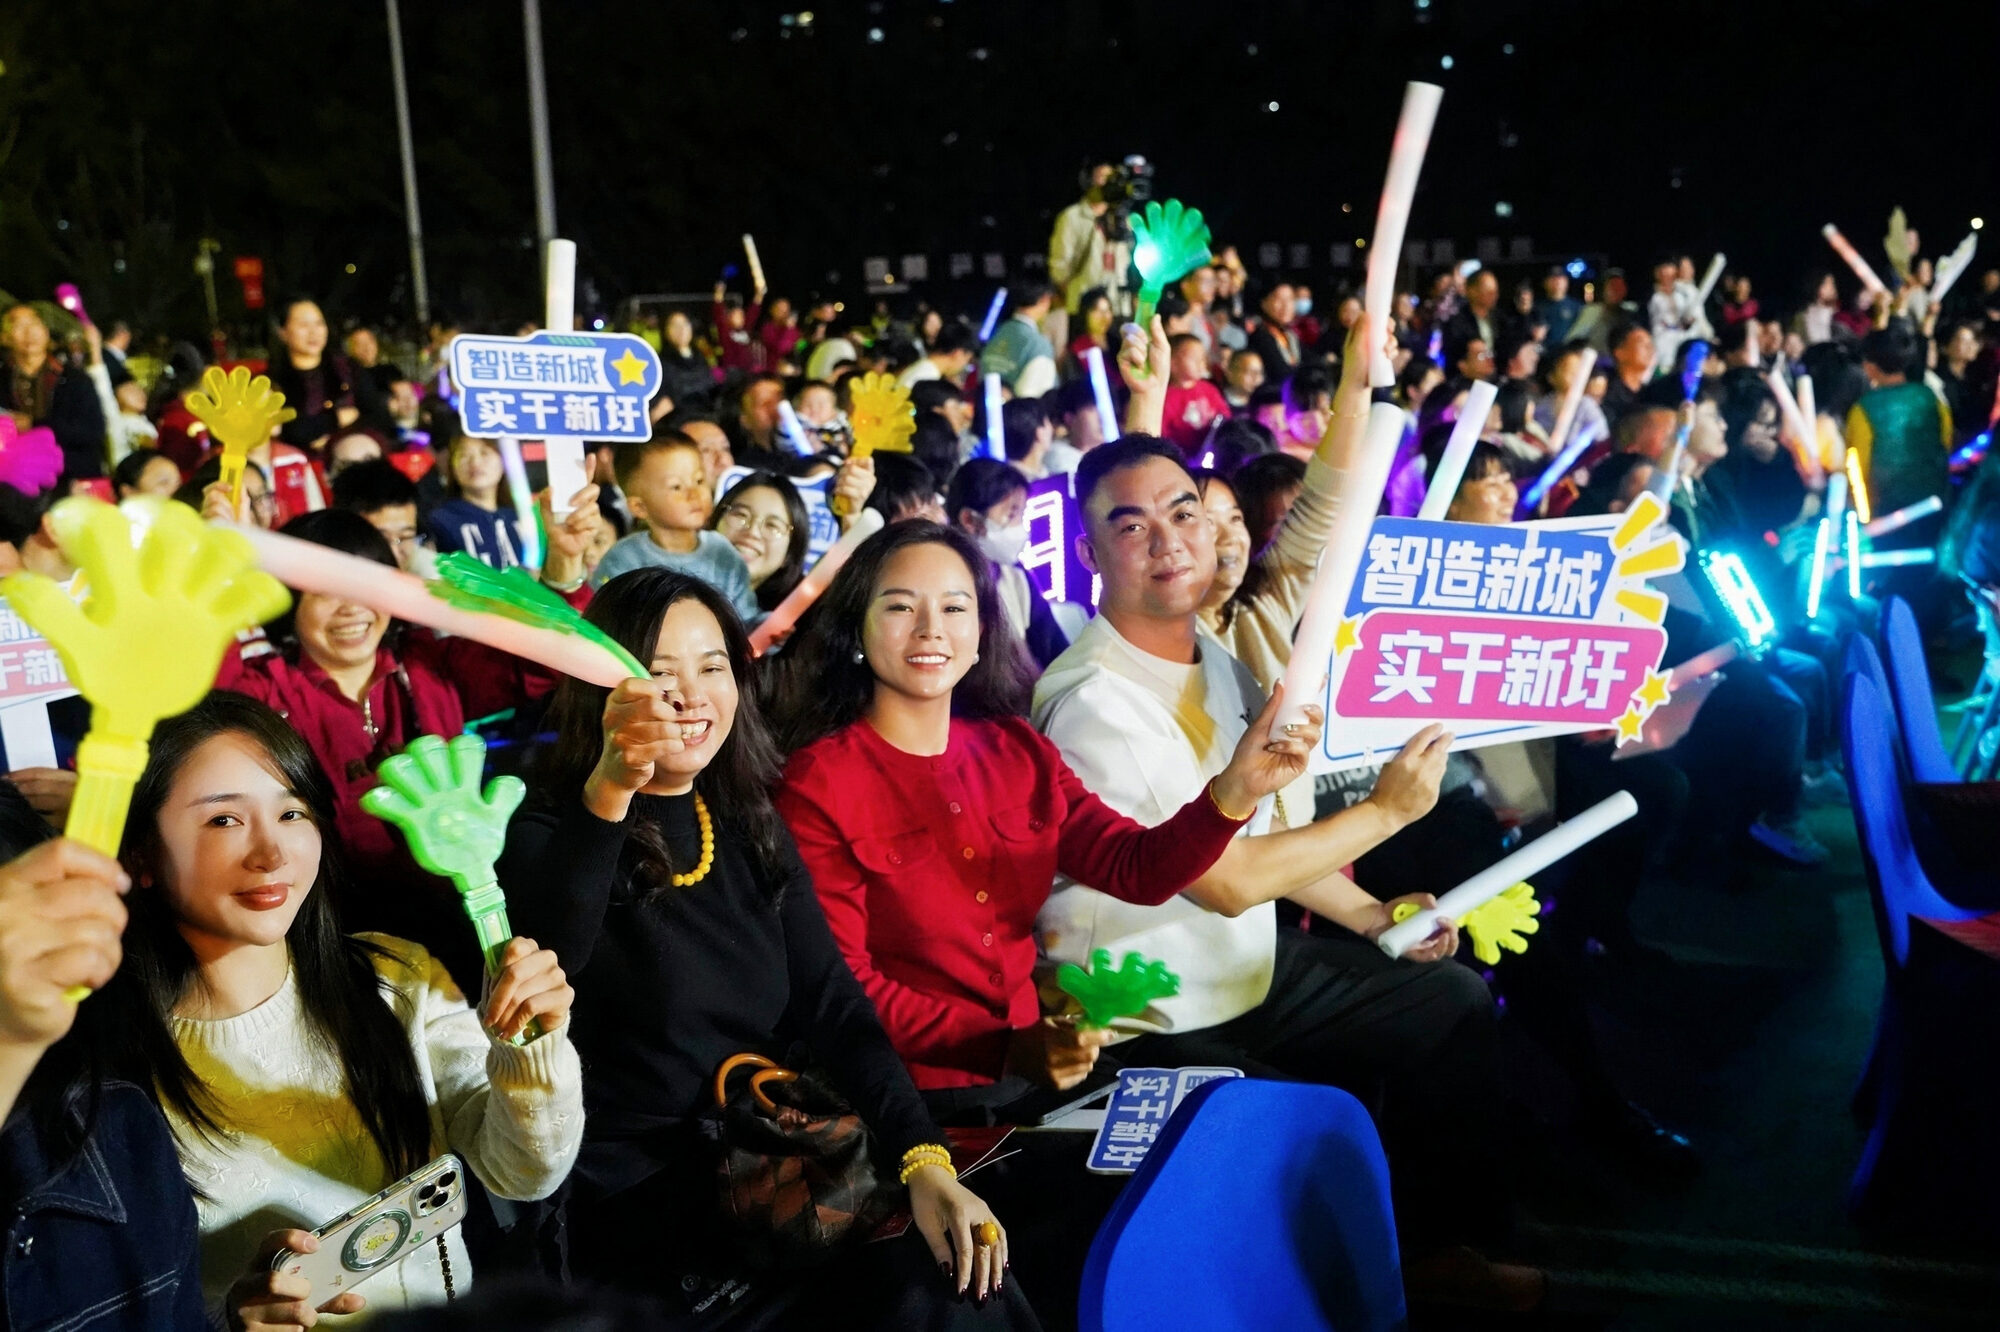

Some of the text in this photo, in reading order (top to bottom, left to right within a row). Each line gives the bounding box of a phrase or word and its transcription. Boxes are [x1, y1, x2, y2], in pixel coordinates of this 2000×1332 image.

[468, 348, 599, 385] 智造新城
[475, 390, 641, 433] 实干新圩
[460, 518, 523, 571] GA
[1360, 533, 1604, 617] 智造新城
[1368, 629, 1631, 711] 实干新圩
